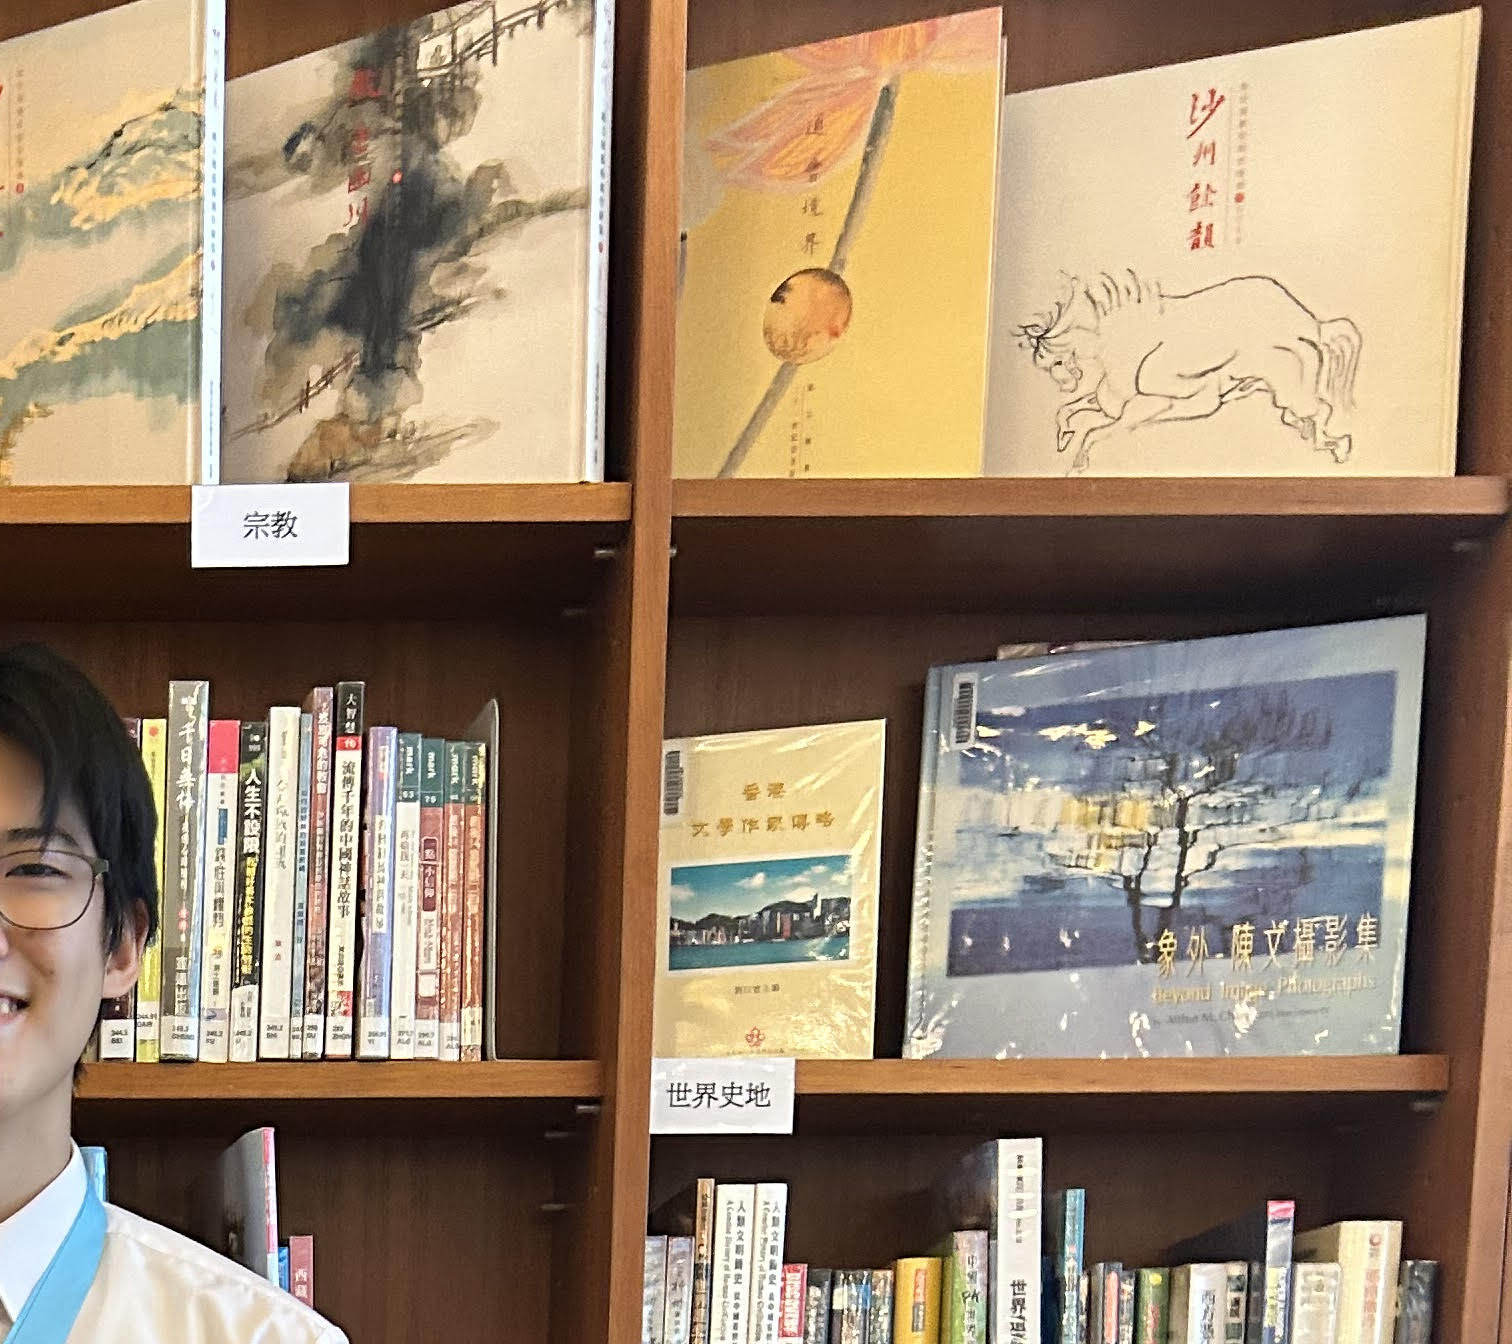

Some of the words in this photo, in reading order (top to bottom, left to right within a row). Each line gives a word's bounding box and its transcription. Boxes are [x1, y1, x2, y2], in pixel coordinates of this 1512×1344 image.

[243, 510, 298, 539] 宗教
[666, 1081, 772, 1109] 世界史地
